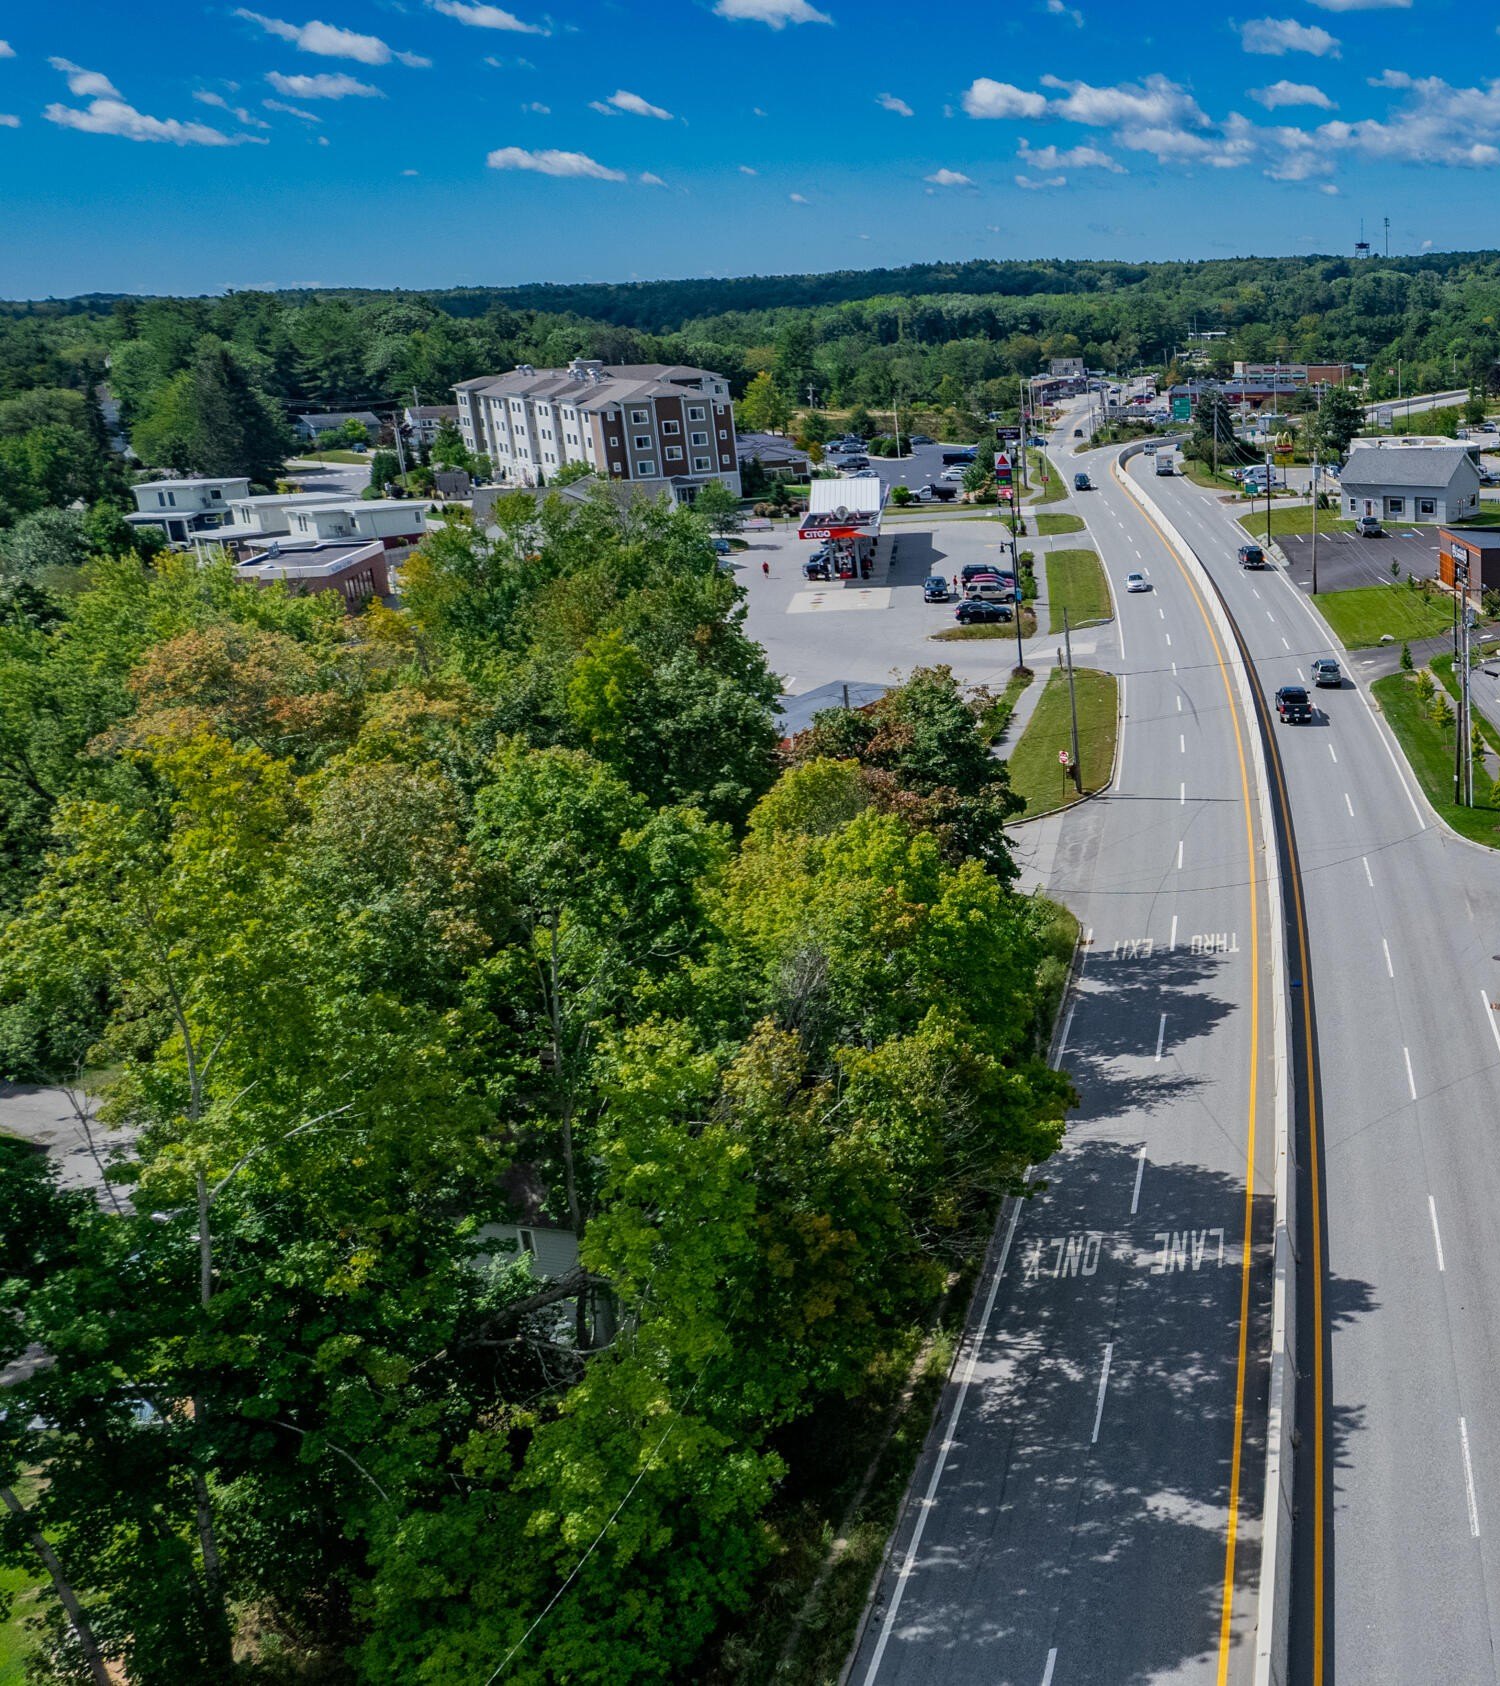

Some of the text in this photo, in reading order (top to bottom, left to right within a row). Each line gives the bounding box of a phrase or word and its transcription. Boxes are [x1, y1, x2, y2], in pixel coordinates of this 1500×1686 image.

[804, 530, 831, 538] CITGO
[1109, 938, 1154, 961] EXIT
[1191, 932, 1240, 955] THRU
[1024, 1235, 1102, 1281] ONLY
[1150, 1228, 1224, 1275] LANE
